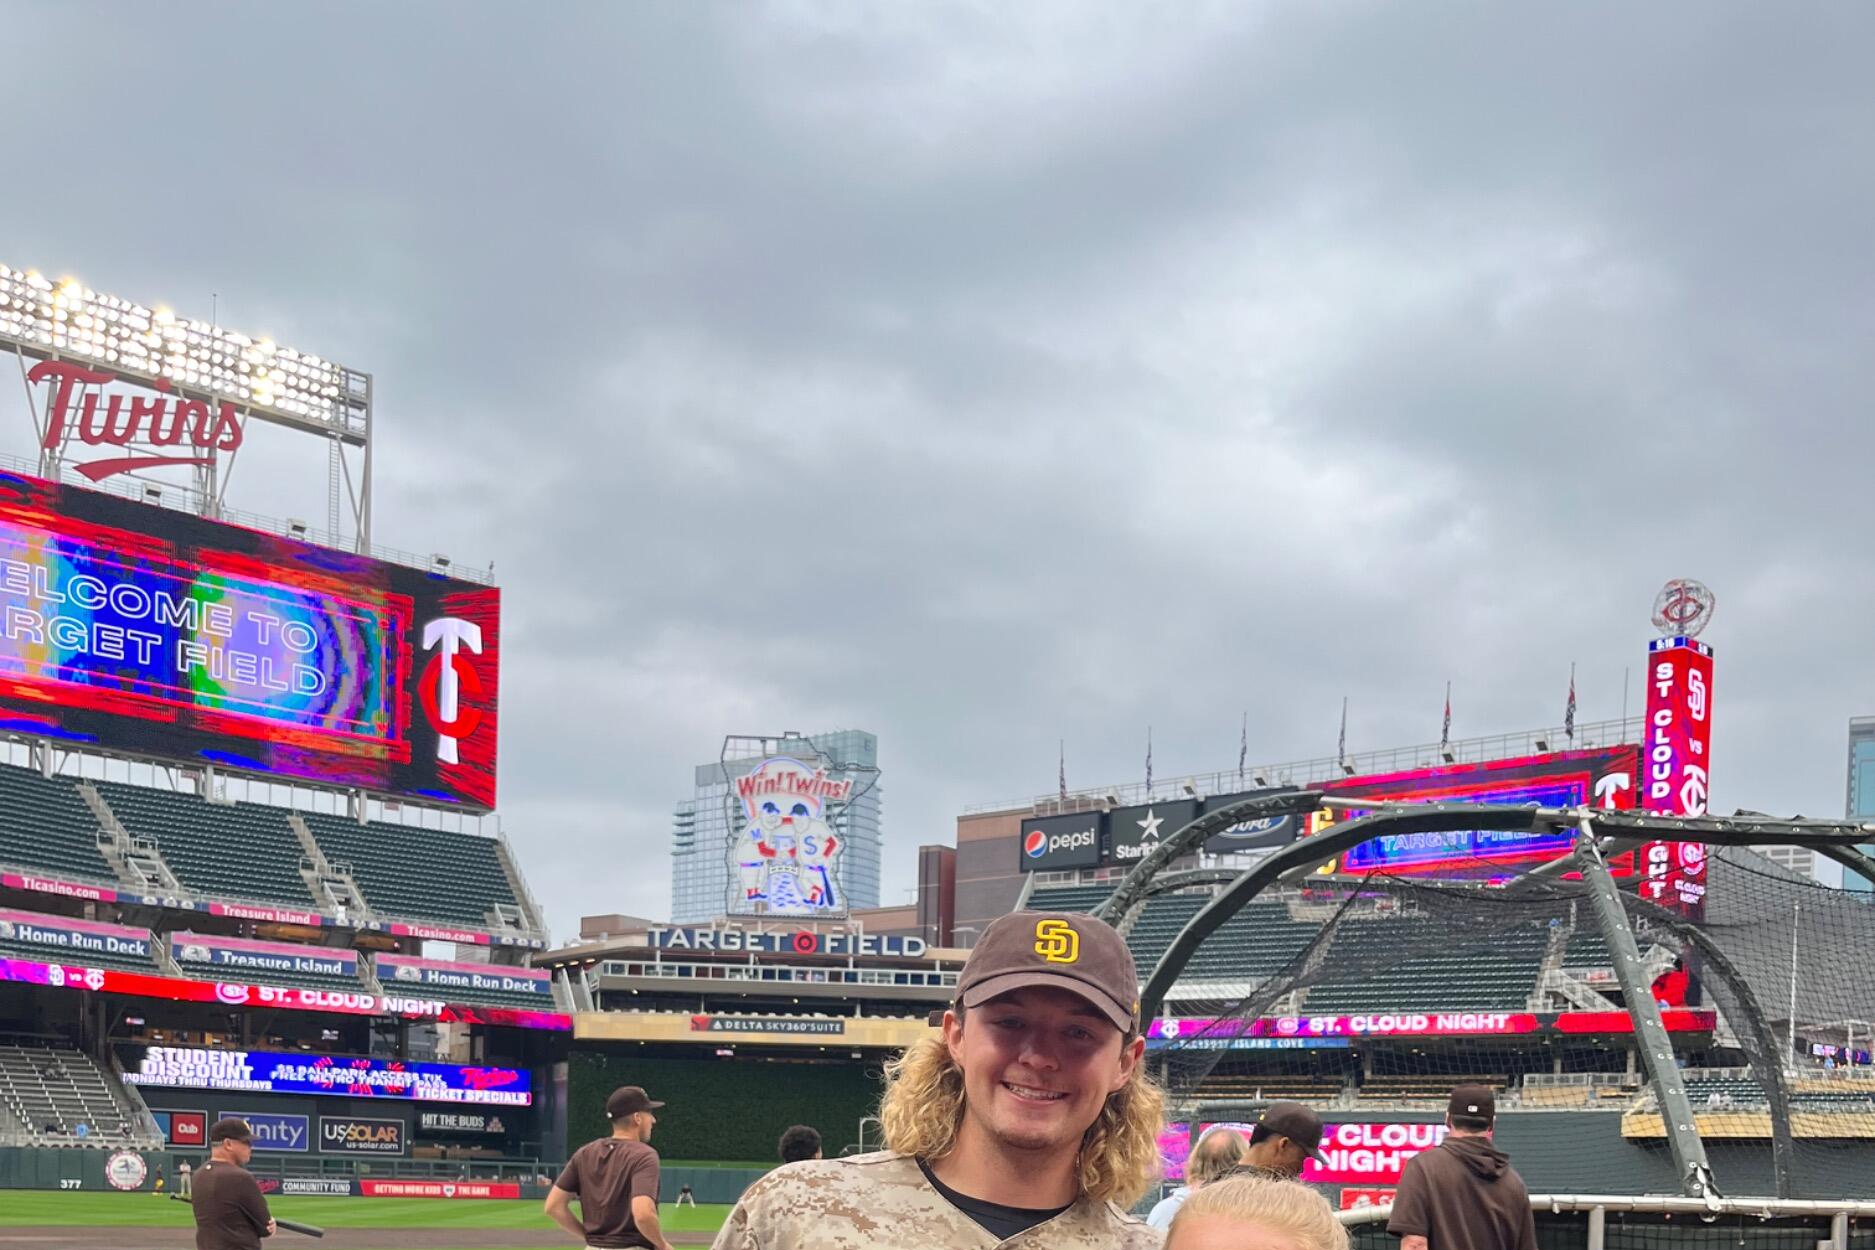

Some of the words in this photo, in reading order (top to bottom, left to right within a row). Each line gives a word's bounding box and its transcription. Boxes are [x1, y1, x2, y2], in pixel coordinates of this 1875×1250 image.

[28, 360, 243, 451] Twins
[0, 558, 233, 637] ELCOME
[248, 611, 318, 653] TO
[0, 605, 162, 665] RGET
[177, 639, 326, 697] FIELD
[1656, 662, 1673, 698] ST
[1651, 710, 1673, 799] CLOUD
[737, 771, 784, 797] Win!
[786, 768, 851, 799] Twins!
[1225, 817, 1272, 832] ord
[1049, 828, 1095, 852] pepsi
[221, 904, 273, 922] Treasure
[275, 911, 310, 924] Island
[18, 925, 67, 945] Home
[71, 931, 102, 950] Run
[106, 935, 145, 955] Deck
[648, 928, 788, 952] TARGET
[825, 934, 926, 957] FIELD
[1034, 919, 1080, 963] SD
[220, 950, 291, 968] Treasure
[295, 957, 342, 974] Island
[428, 969, 469, 986] Home
[472, 975, 500, 989] Run
[503, 978, 537, 993] Deck
[259, 986, 292, 1002] ST.
[301, 990, 375, 1009] CLOUD
[383, 998, 445, 1016] NIGHT
[725, 1020, 764, 1031] DELTA
[1309, 1016, 1341, 1032] ST.
[1351, 1015, 1429, 1032] CLOUD
[1437, 1013, 1510, 1031] NIGHT
[147, 1046, 248, 1066] STUDENT
[141, 1059, 254, 1081] DISCOUNT
[301, 1066, 367, 1078] BALLPARK
[369, 1070, 420, 1081] ACCESS
[422, 1073, 443, 1082] TIX
[178, 1076, 208, 1087] THRU
[210, 1078, 272, 1090] THURSDAYS
[417, 1087, 464, 1102] TICKET
[465, 1089, 528, 1105] SPECIALS
[422, 1113, 439, 1125] HIT
[440, 1114, 457, 1126] THE
[459, 1115, 485, 1127] BUDS
[346, 1142, 398, 1150] us-solar.com
[60, 1179, 82, 1189] 377
[282, 1182, 329, 1192] COMMUNITY
[331, 1183, 350, 1193] FUND
